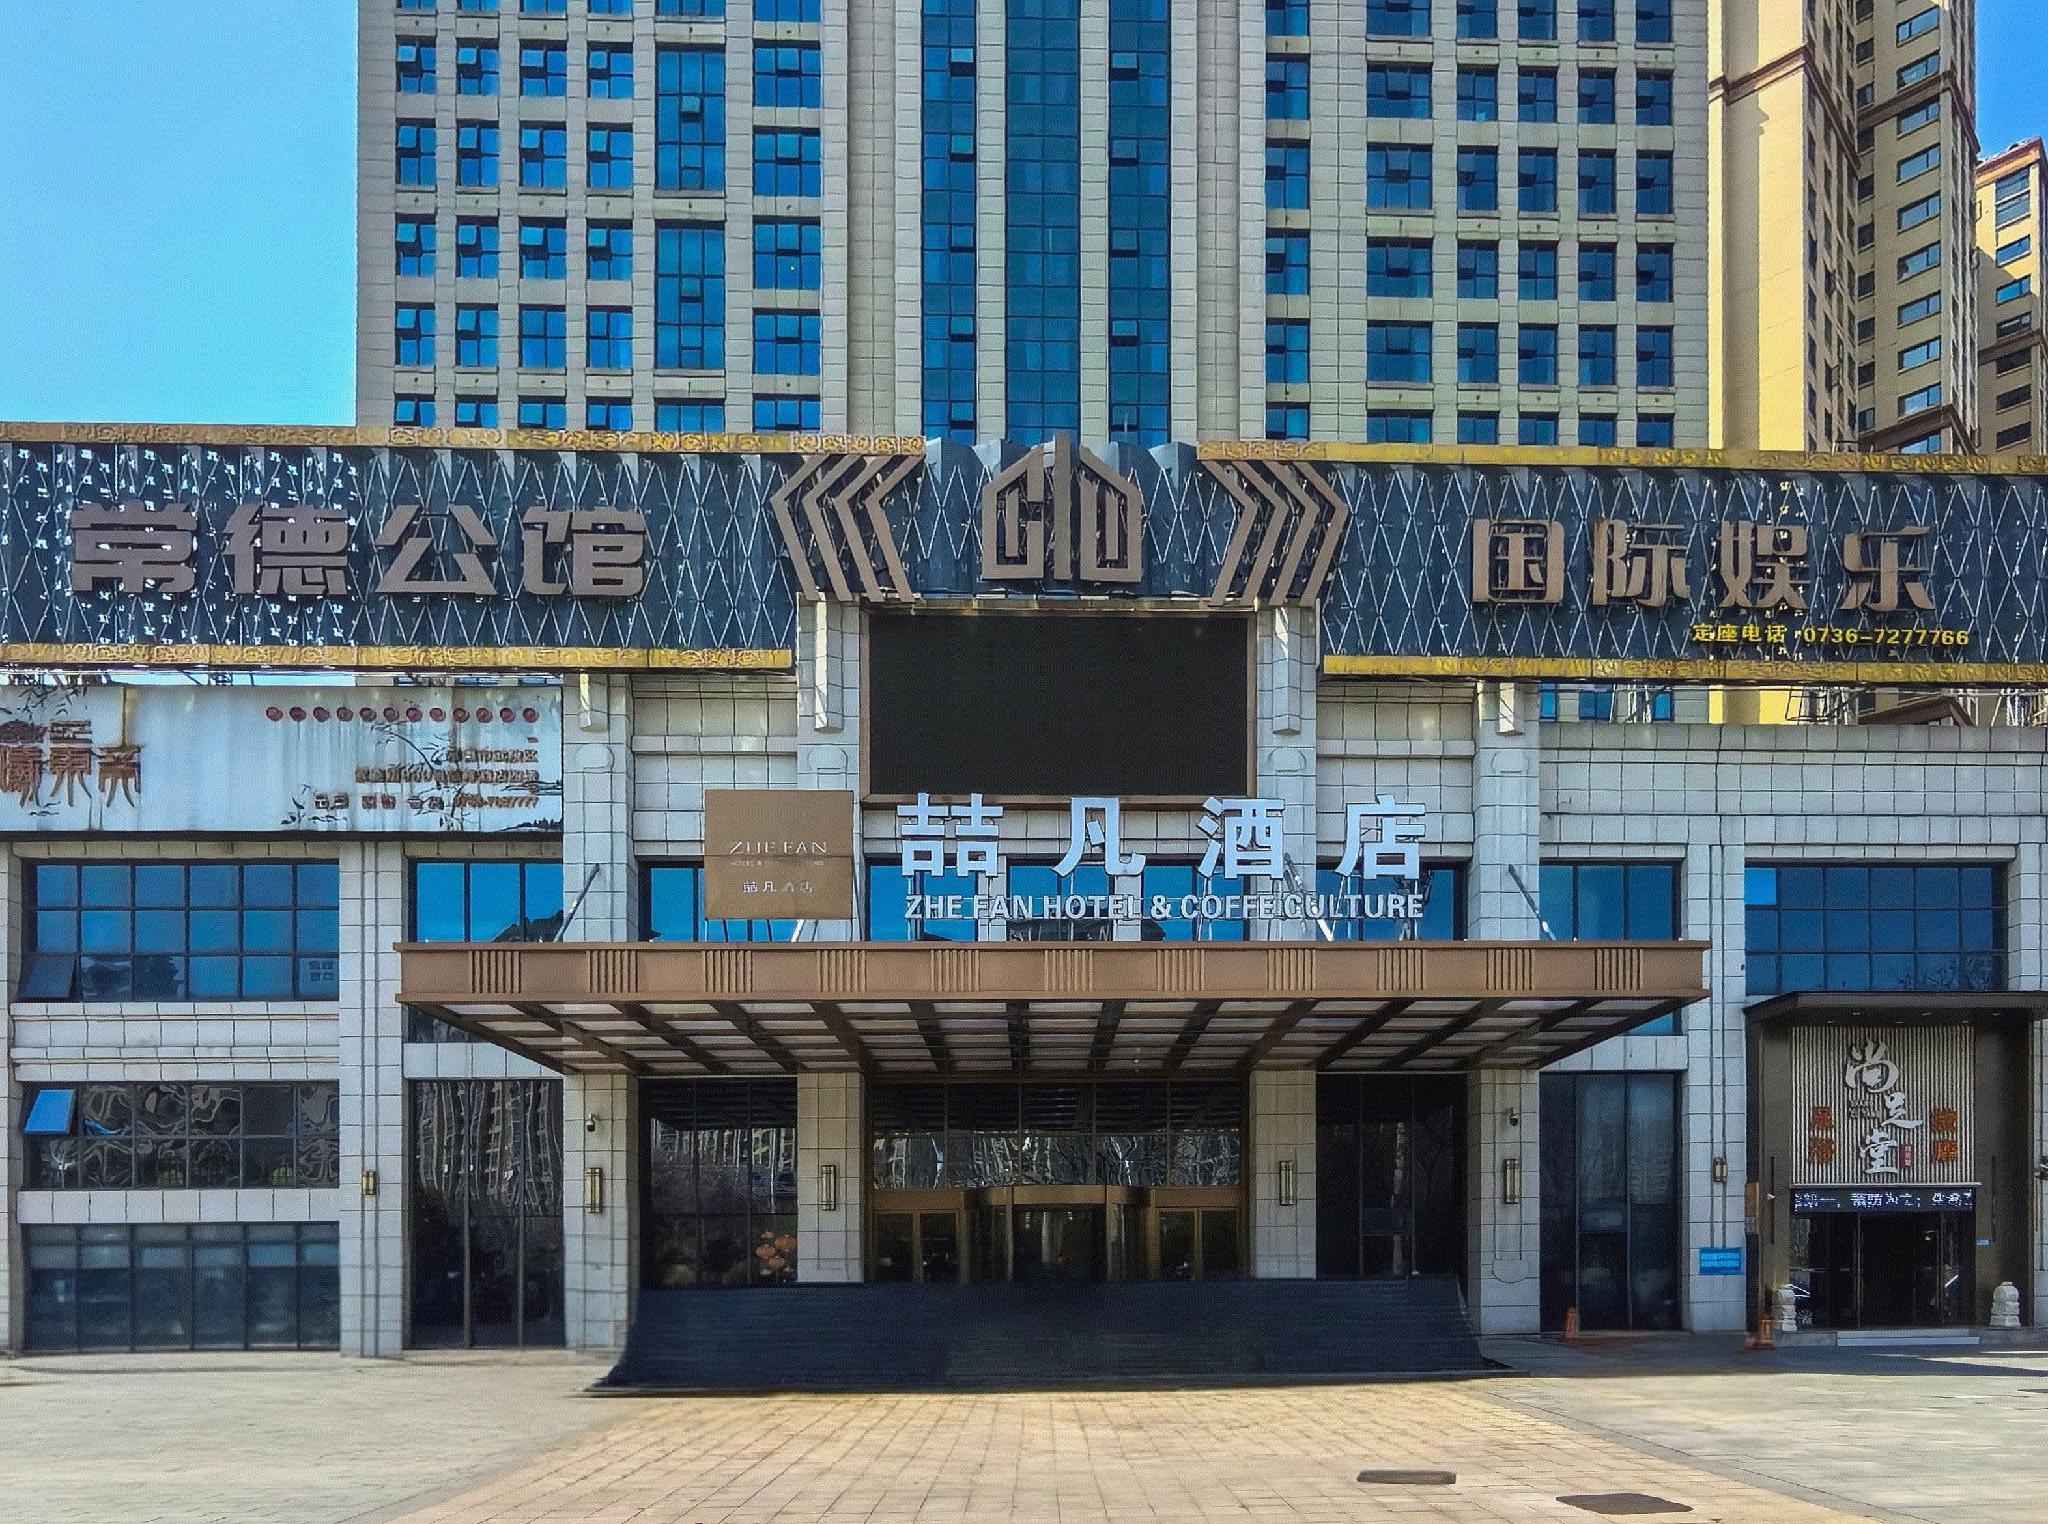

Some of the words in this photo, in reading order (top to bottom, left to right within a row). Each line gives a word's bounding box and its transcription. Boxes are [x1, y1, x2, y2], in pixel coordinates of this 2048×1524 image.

[70, 501, 649, 597] 常德公馆
[1472, 517, 1936, 613] 国际娱乐
[1691, 623, 1787, 642] 定座电话
[783, 841, 827, 854] FAN
[897, 793, 1427, 880] 喆凡酒店
[904, 895, 963, 919] ZHE
[973, 895, 1033, 919] FAN
[1043, 895, 1142, 919] HOTEL
[1150, 895, 1172, 919] &
[1180, 895, 1275, 919] COFFE
[1284, 894, 1424, 918] CULTURE
